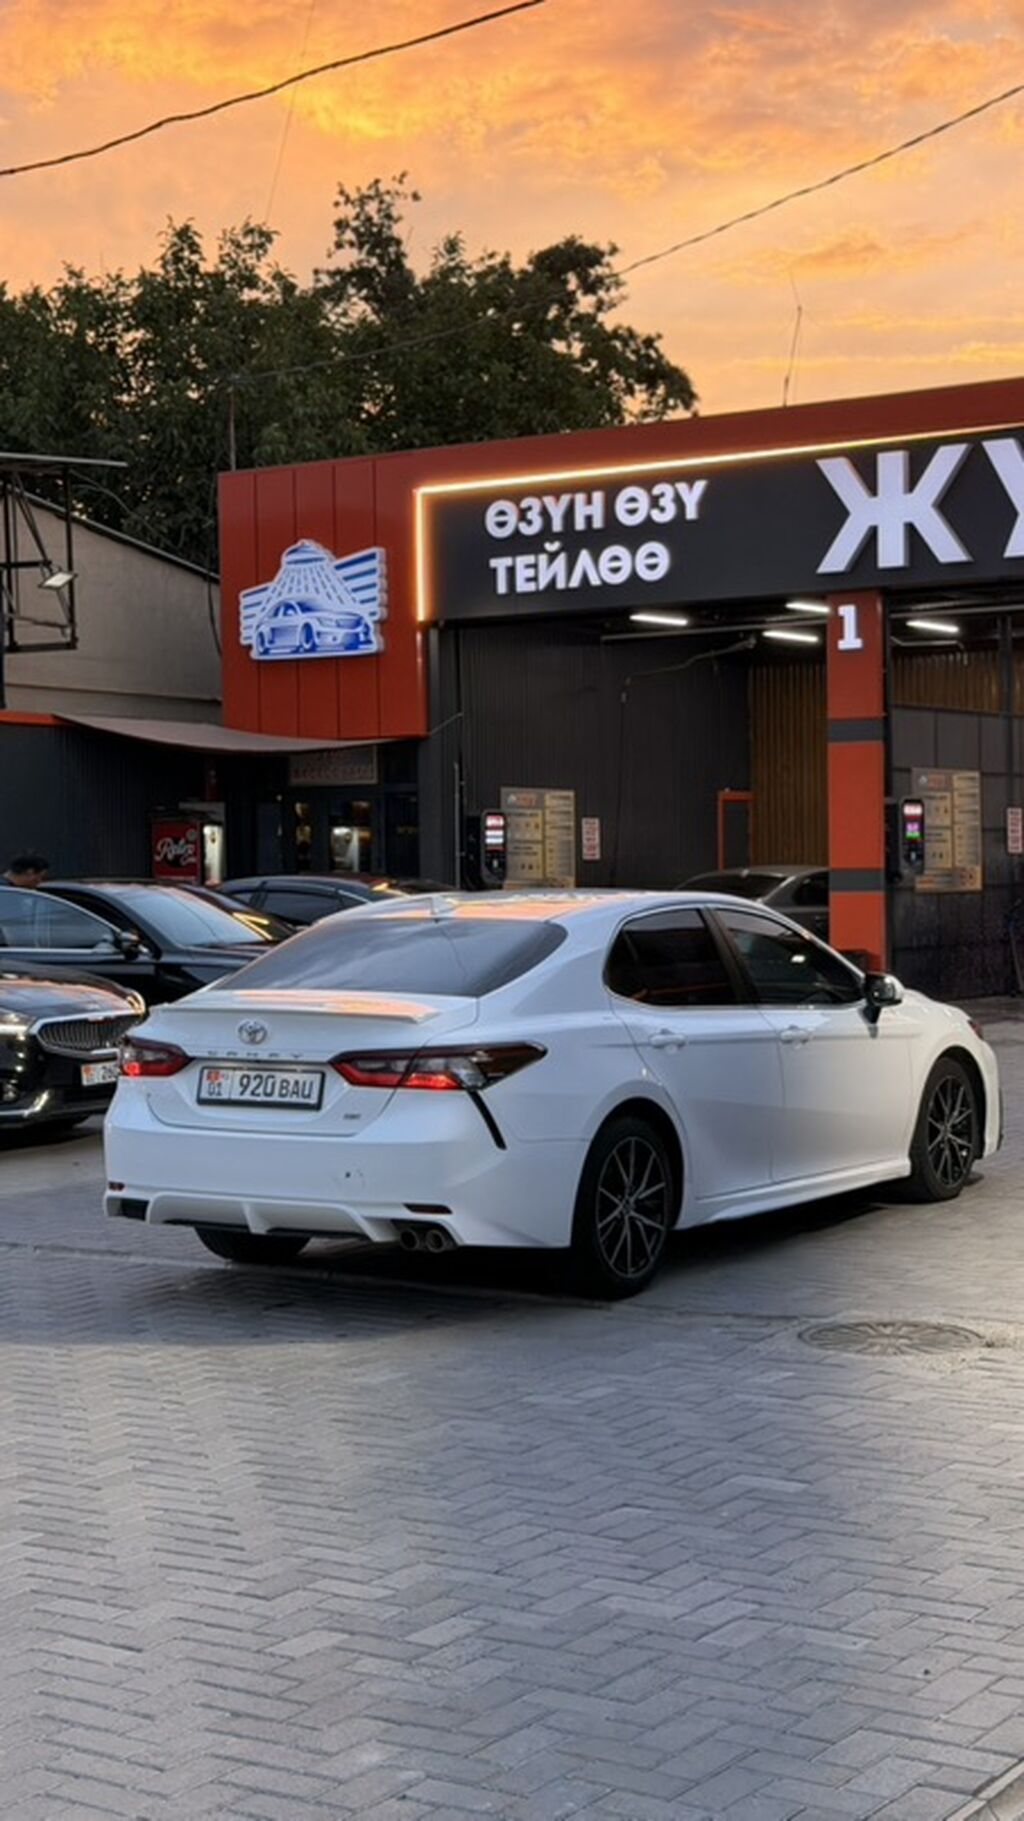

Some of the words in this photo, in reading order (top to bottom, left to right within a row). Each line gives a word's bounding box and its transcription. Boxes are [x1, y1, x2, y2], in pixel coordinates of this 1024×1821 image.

[485, 491, 606, 539] ӨЗҮН
[615, 480, 708, 526] ӨЗҮ
[489, 541, 671, 595] ТЕЙЛӨӨ
[838, 604, 863, 651] 1
